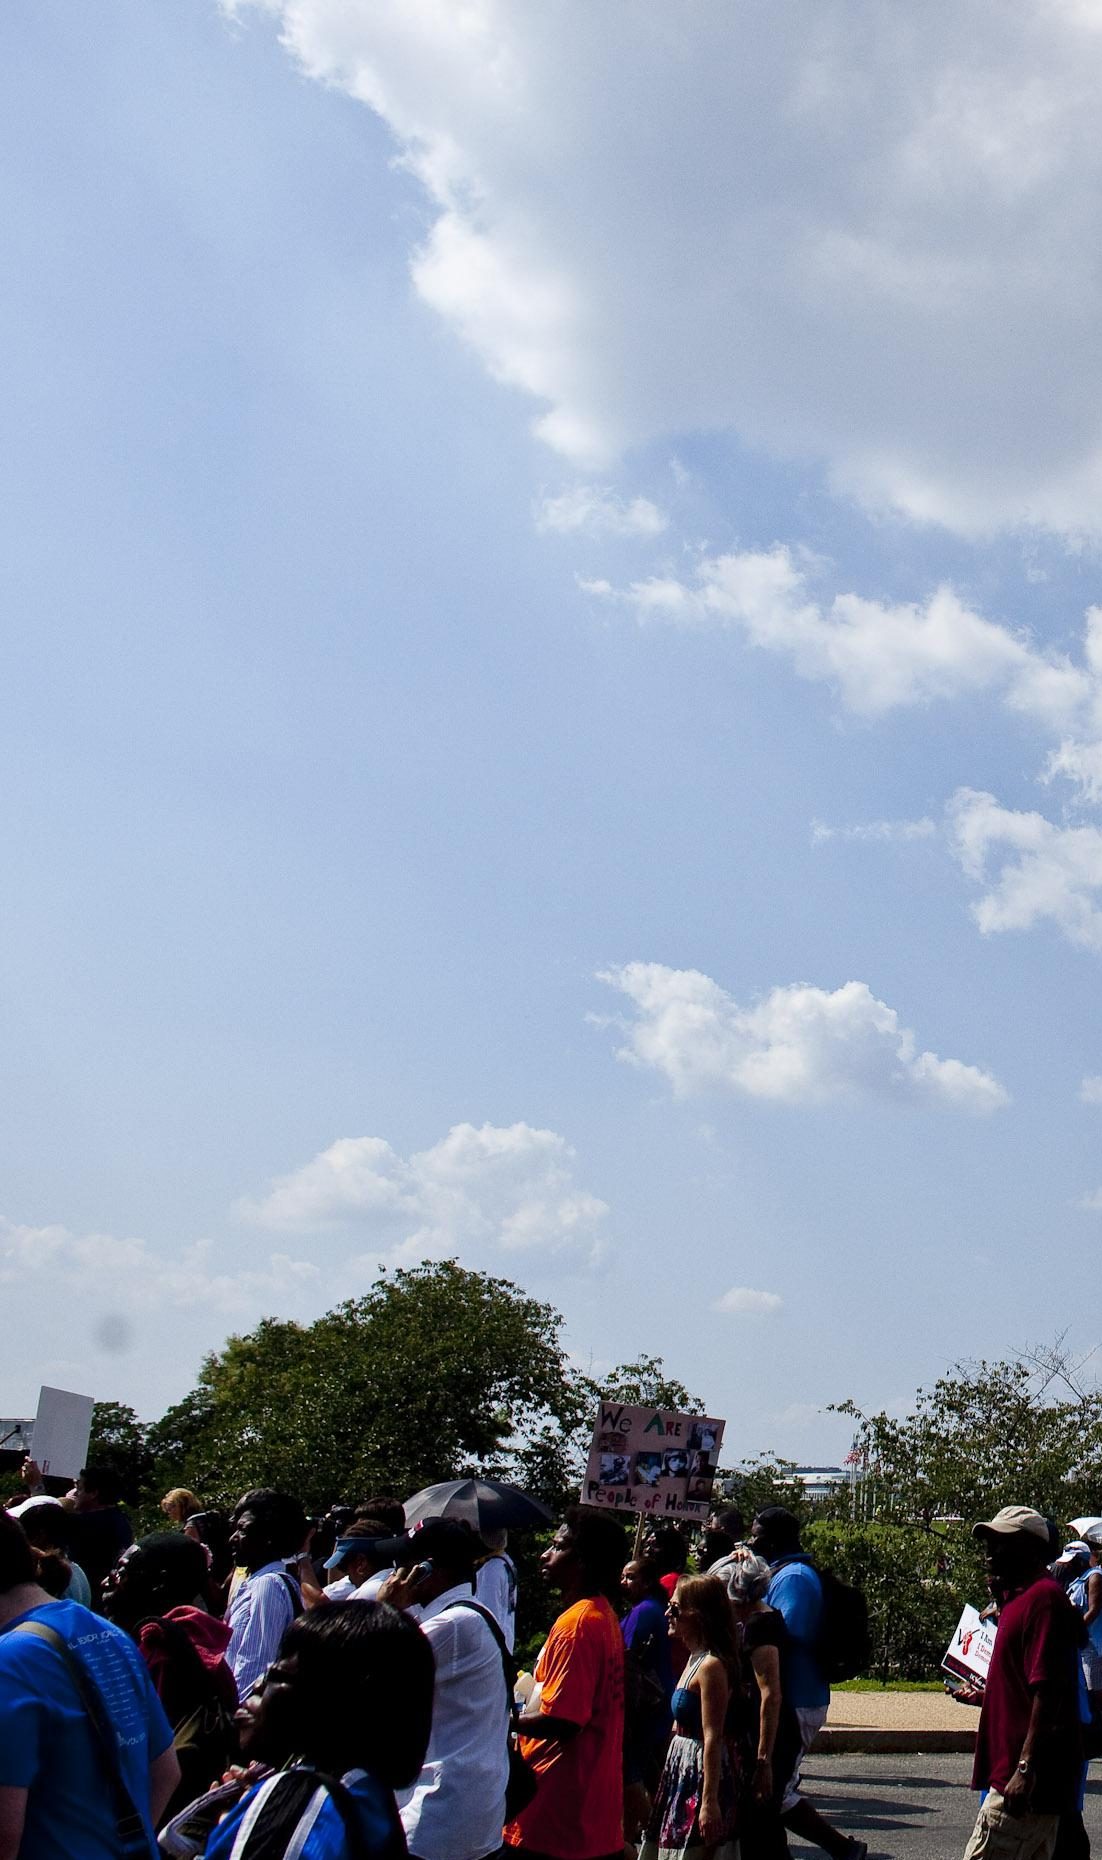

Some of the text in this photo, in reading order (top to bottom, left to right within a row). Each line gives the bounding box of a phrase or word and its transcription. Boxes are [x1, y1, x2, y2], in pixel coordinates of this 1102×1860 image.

[600, 1404, 682, 1437] We ARE
[588, 1480, 637, 1507] People
[644, 1493, 662, 1509] of
